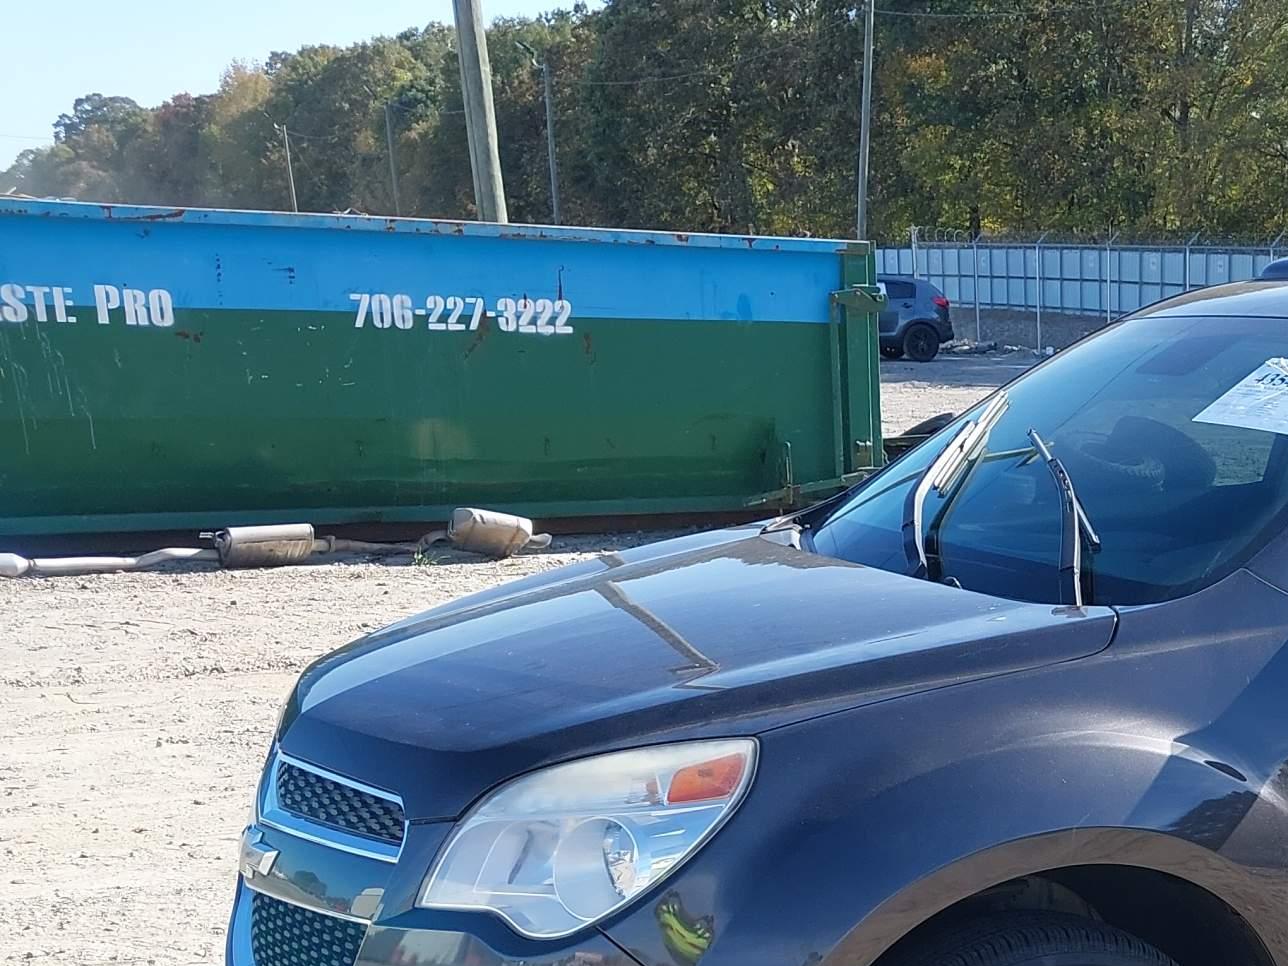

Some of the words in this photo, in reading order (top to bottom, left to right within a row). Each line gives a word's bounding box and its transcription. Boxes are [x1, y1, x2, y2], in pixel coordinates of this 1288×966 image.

[0, 283, 77, 323] STE
[93, 284, 175, 327] PRO
[350, 293, 574, 335] 706-227-3222
